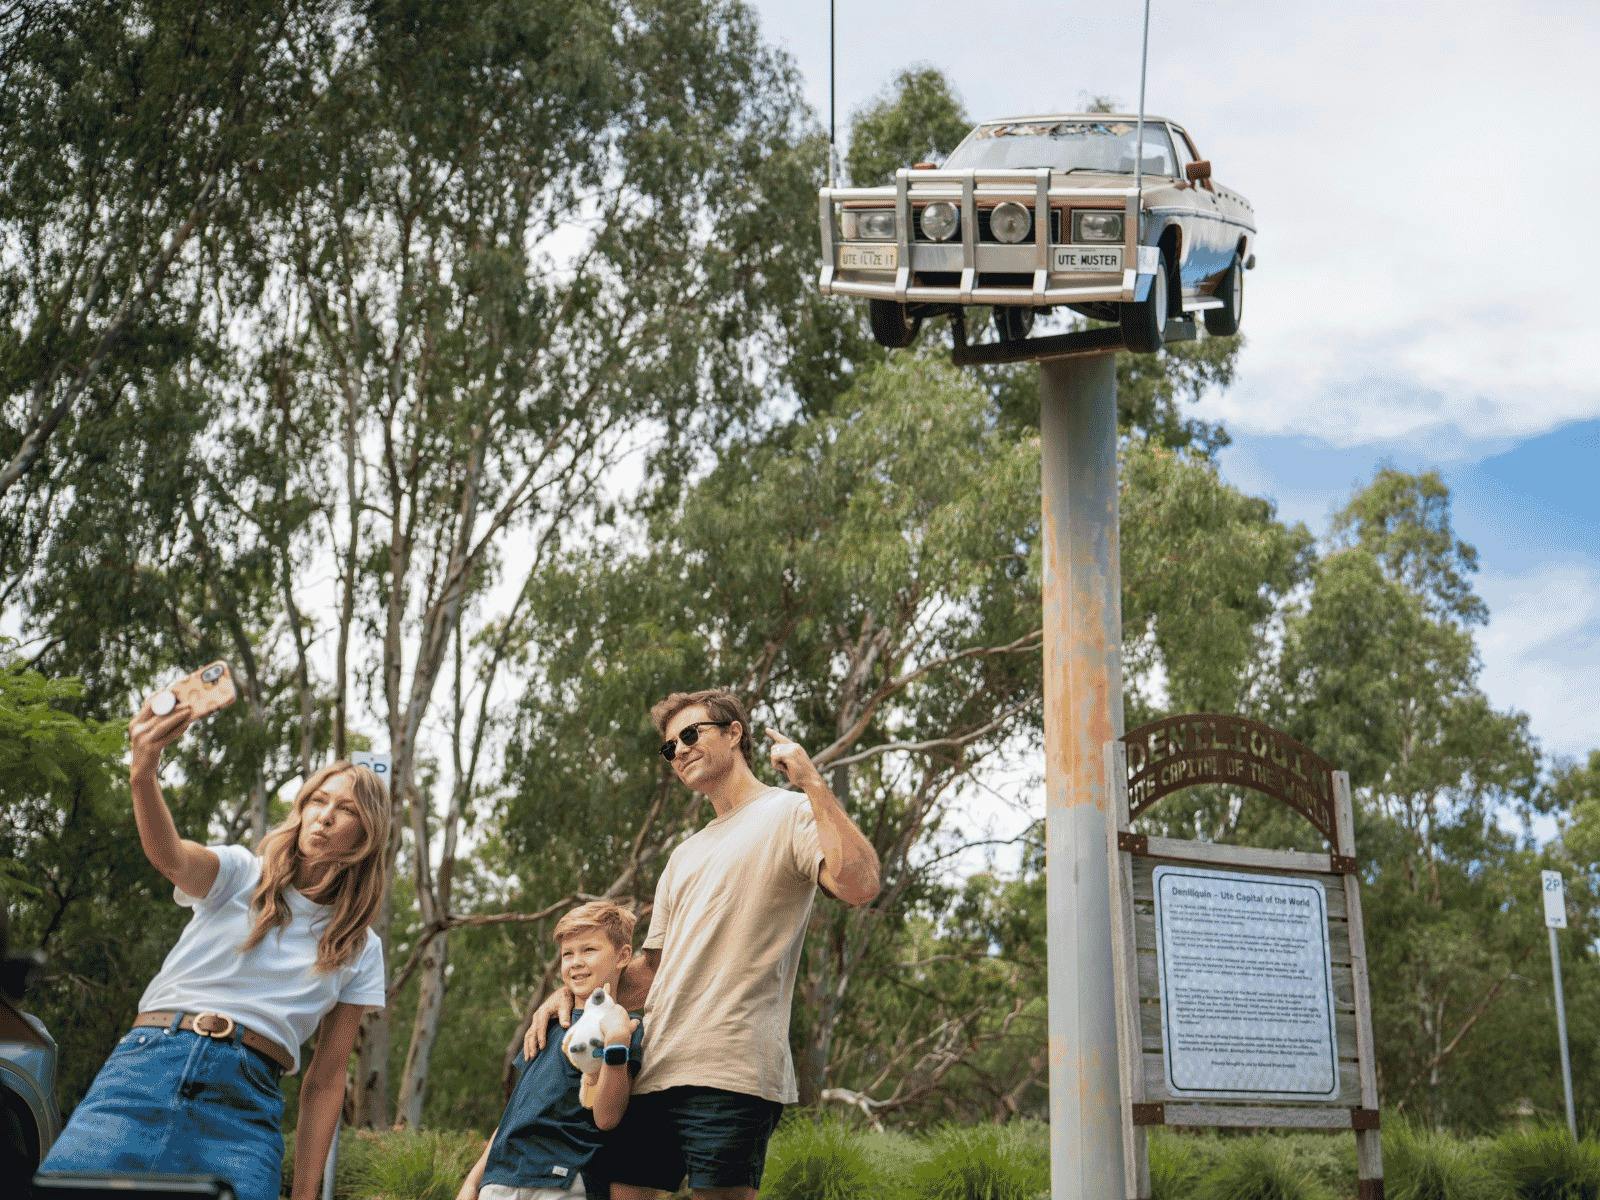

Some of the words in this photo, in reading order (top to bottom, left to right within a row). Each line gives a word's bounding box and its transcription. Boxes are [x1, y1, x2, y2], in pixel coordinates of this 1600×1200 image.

[842, 254, 857, 265] UTE
[1058, 254, 1077, 266] UTE
[1080, 254, 1117, 266] MUSTER
[1128, 721, 1328, 800] DENILIQUIN
[1129, 772, 1156, 810] UTE
[1161, 755, 1221, 785] CAPITAL
[1226, 758, 1244, 777] OF
[1545, 878, 1561, 892] 2P
[1171, 886, 1212, 900] Deniliquin
[1220, 891, 1234, 901] Ute
[1235, 892, 1263, 904] Capital
[1265, 895, 1274, 904] of
[1274, 896, 1286, 905] the
[1288, 897, 1310, 907] World
